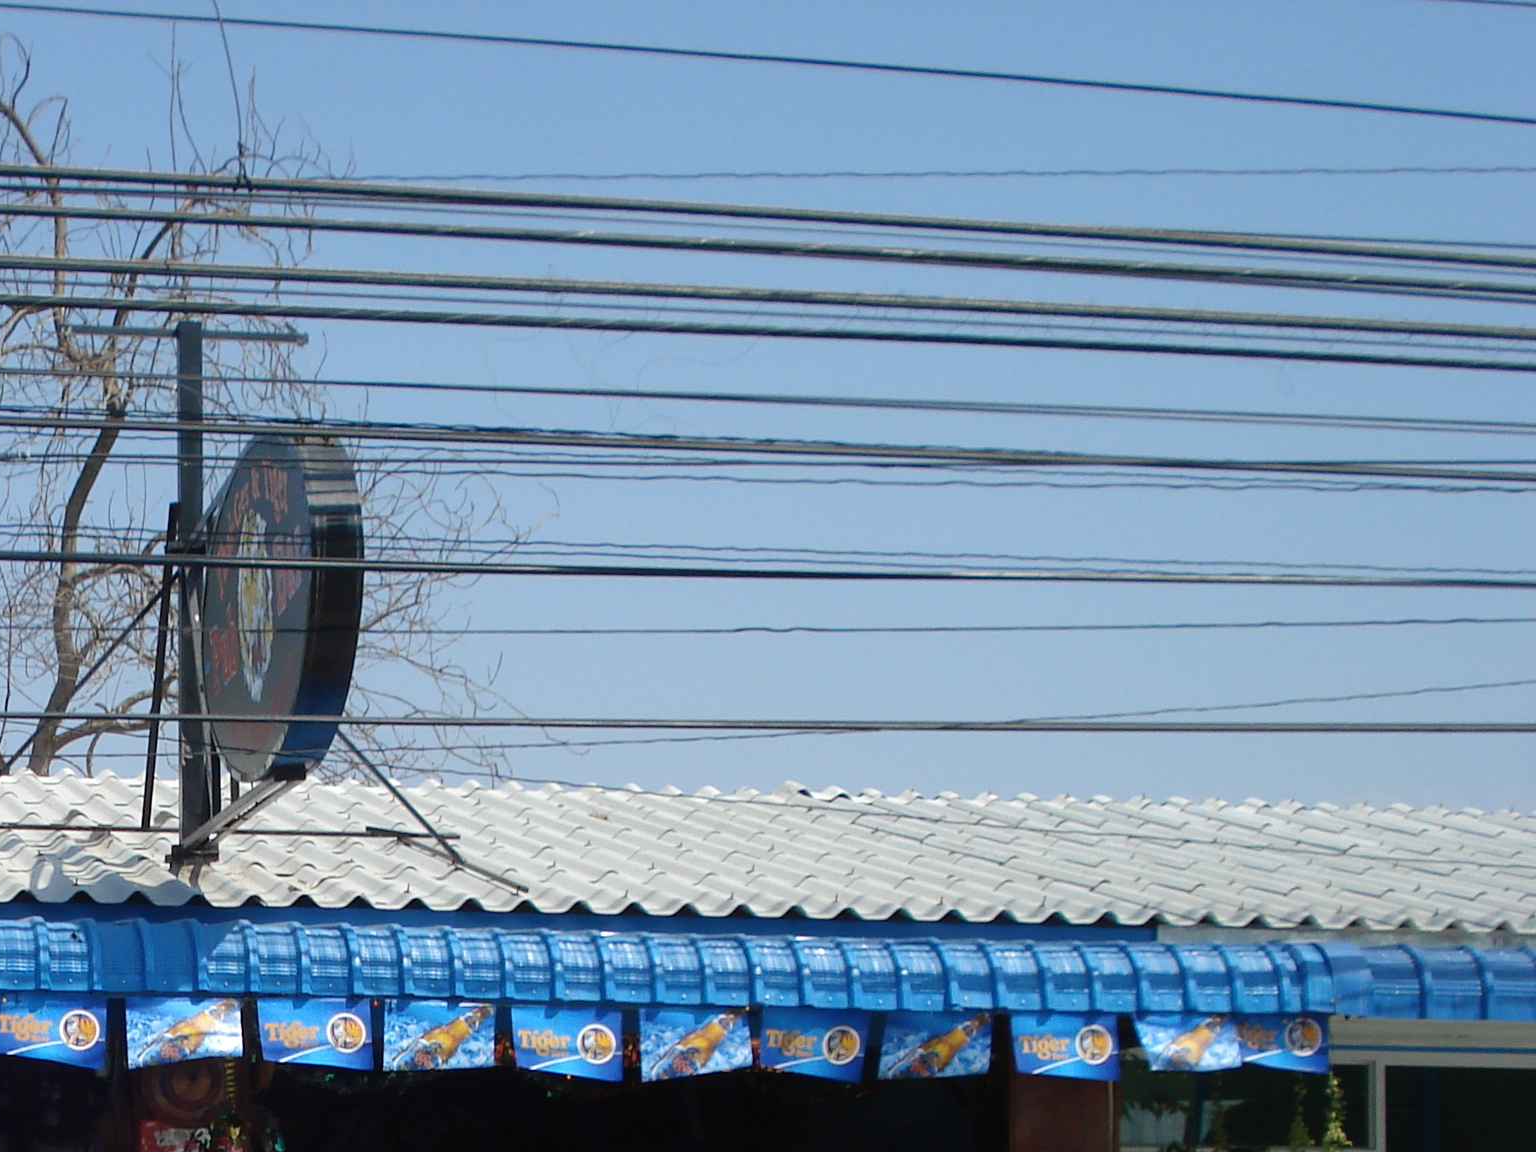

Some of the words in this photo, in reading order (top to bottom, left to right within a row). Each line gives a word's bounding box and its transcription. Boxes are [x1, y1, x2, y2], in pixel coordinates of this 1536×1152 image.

[265, 1022, 319, 1048] Tiger
[518, 1030, 570, 1055] Tiger
[766, 1030, 816, 1056] Tiger
[1019, 1035, 1069, 1060] Tiger
